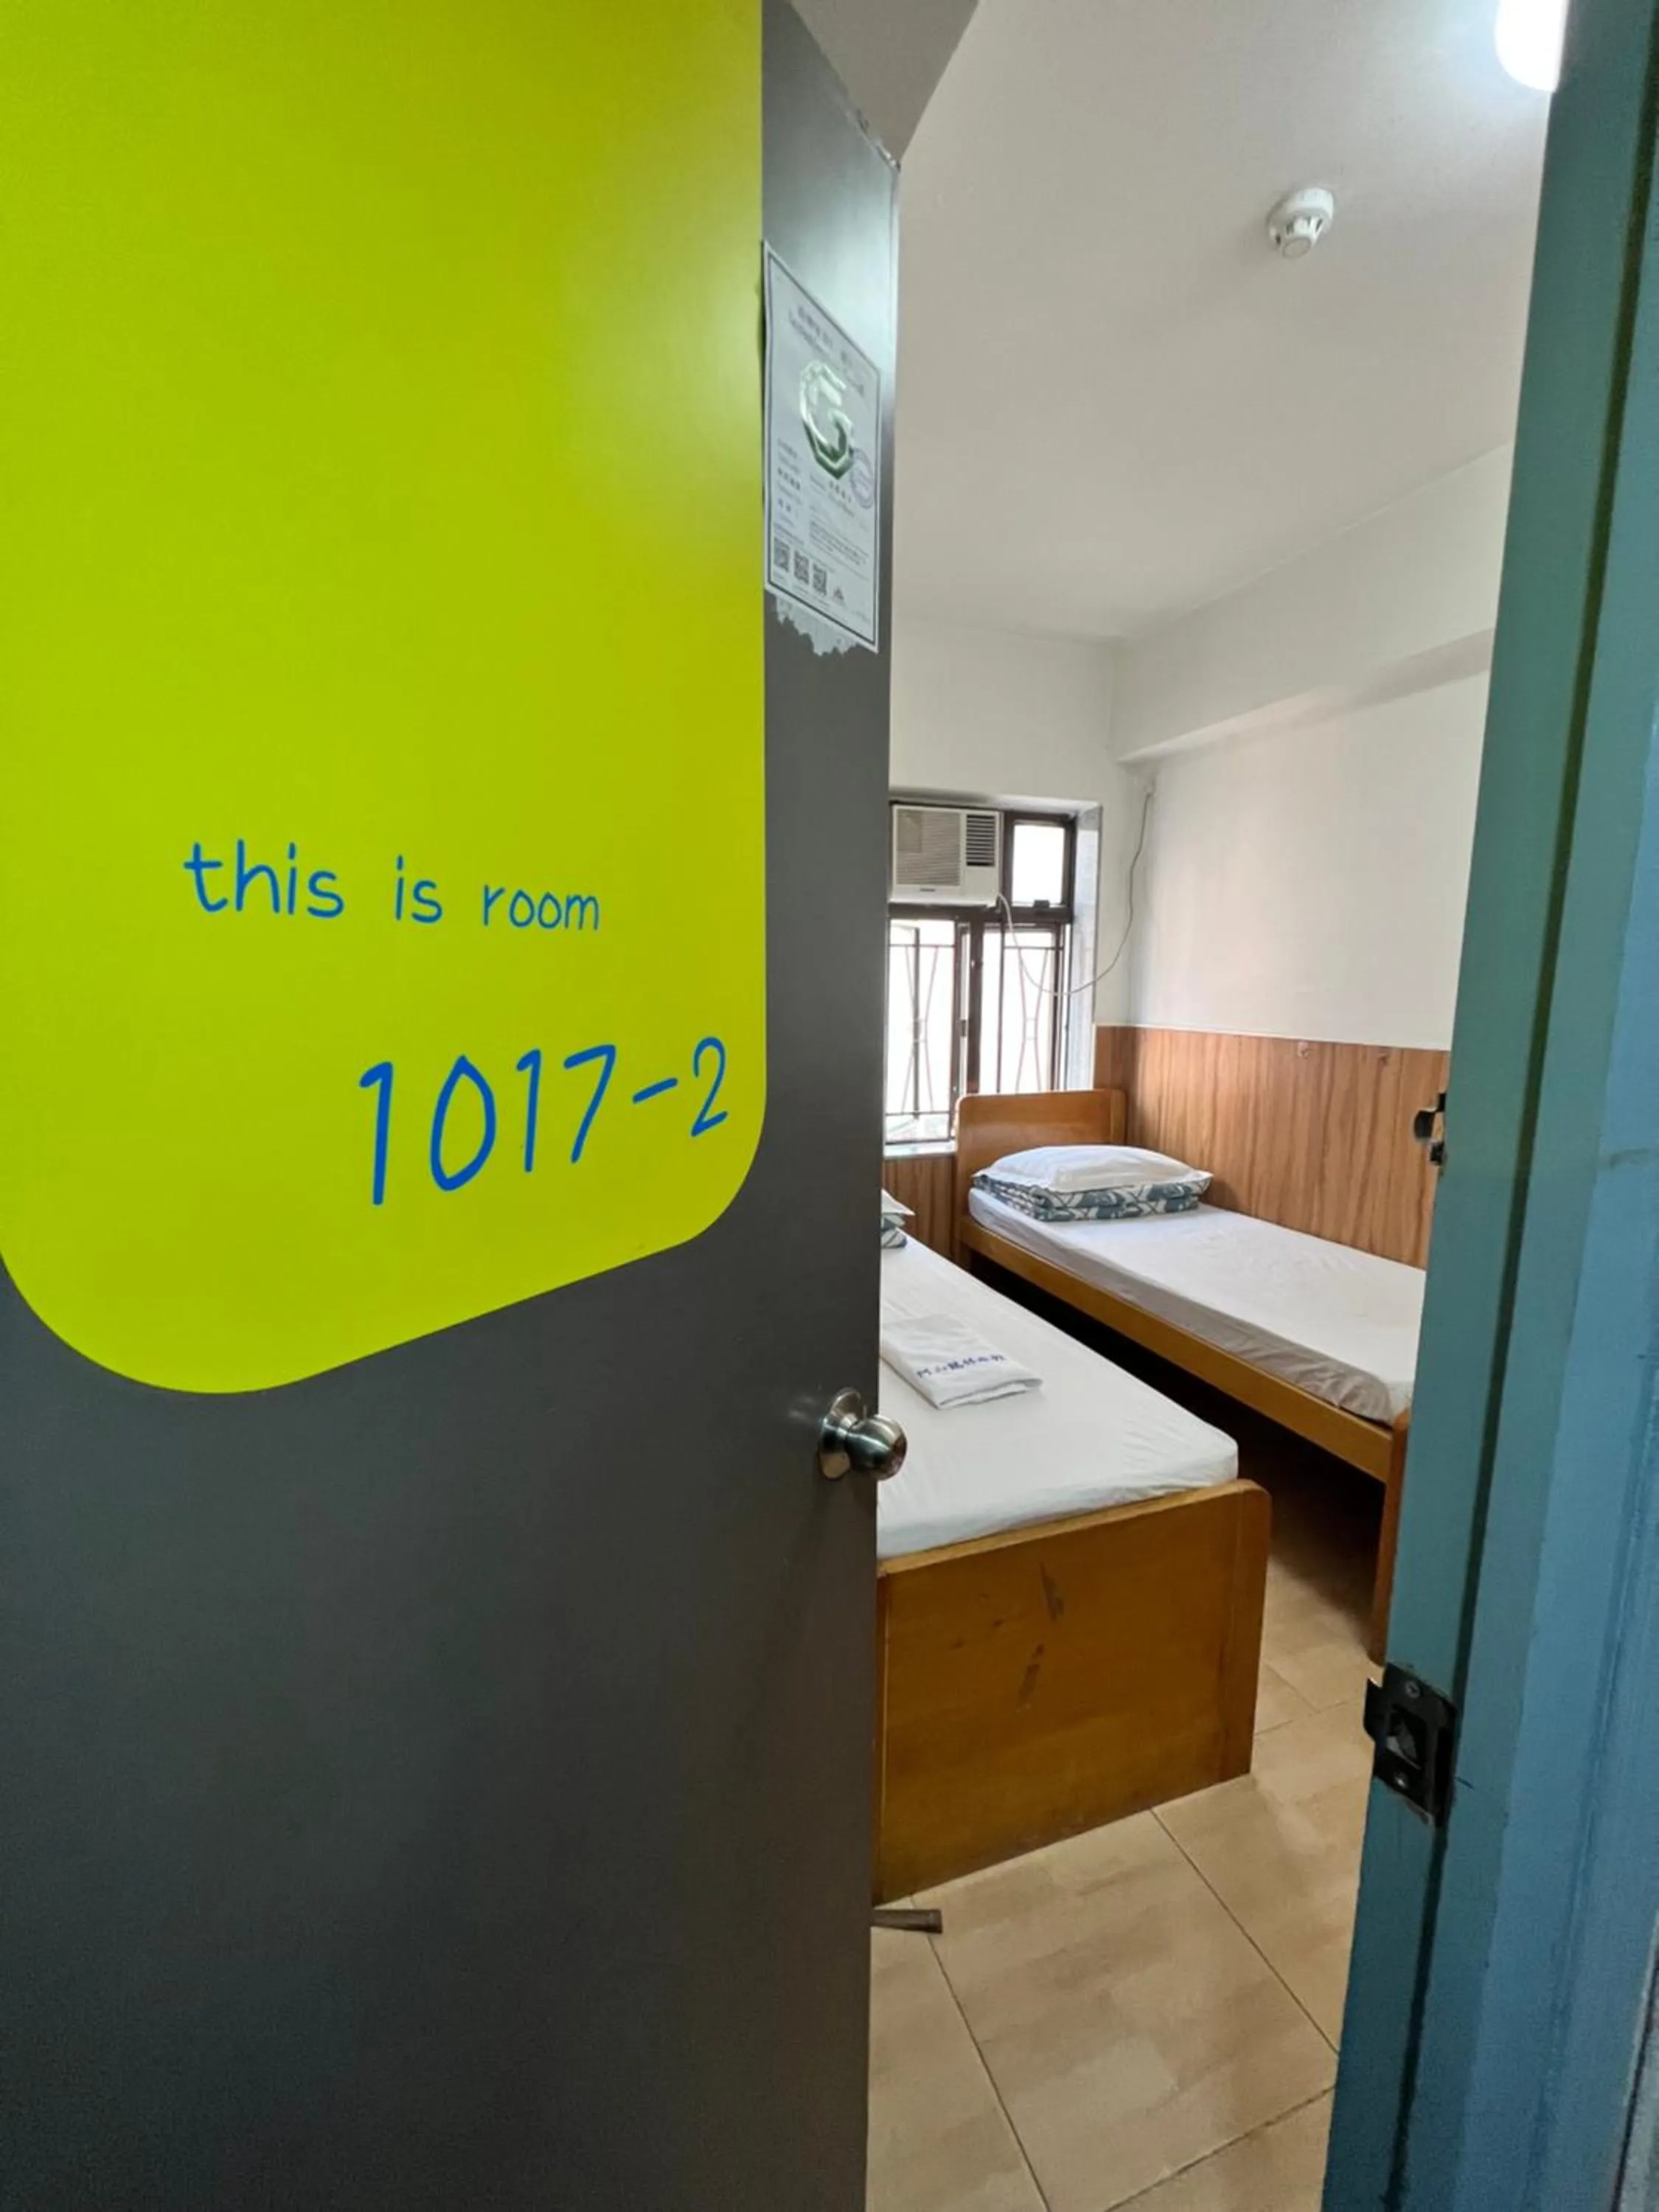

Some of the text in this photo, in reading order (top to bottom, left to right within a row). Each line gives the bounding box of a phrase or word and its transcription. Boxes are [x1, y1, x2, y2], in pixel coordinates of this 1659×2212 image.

[184, 839, 599, 930] this is room
[359, 1037, 728, 1206] 1017-2
